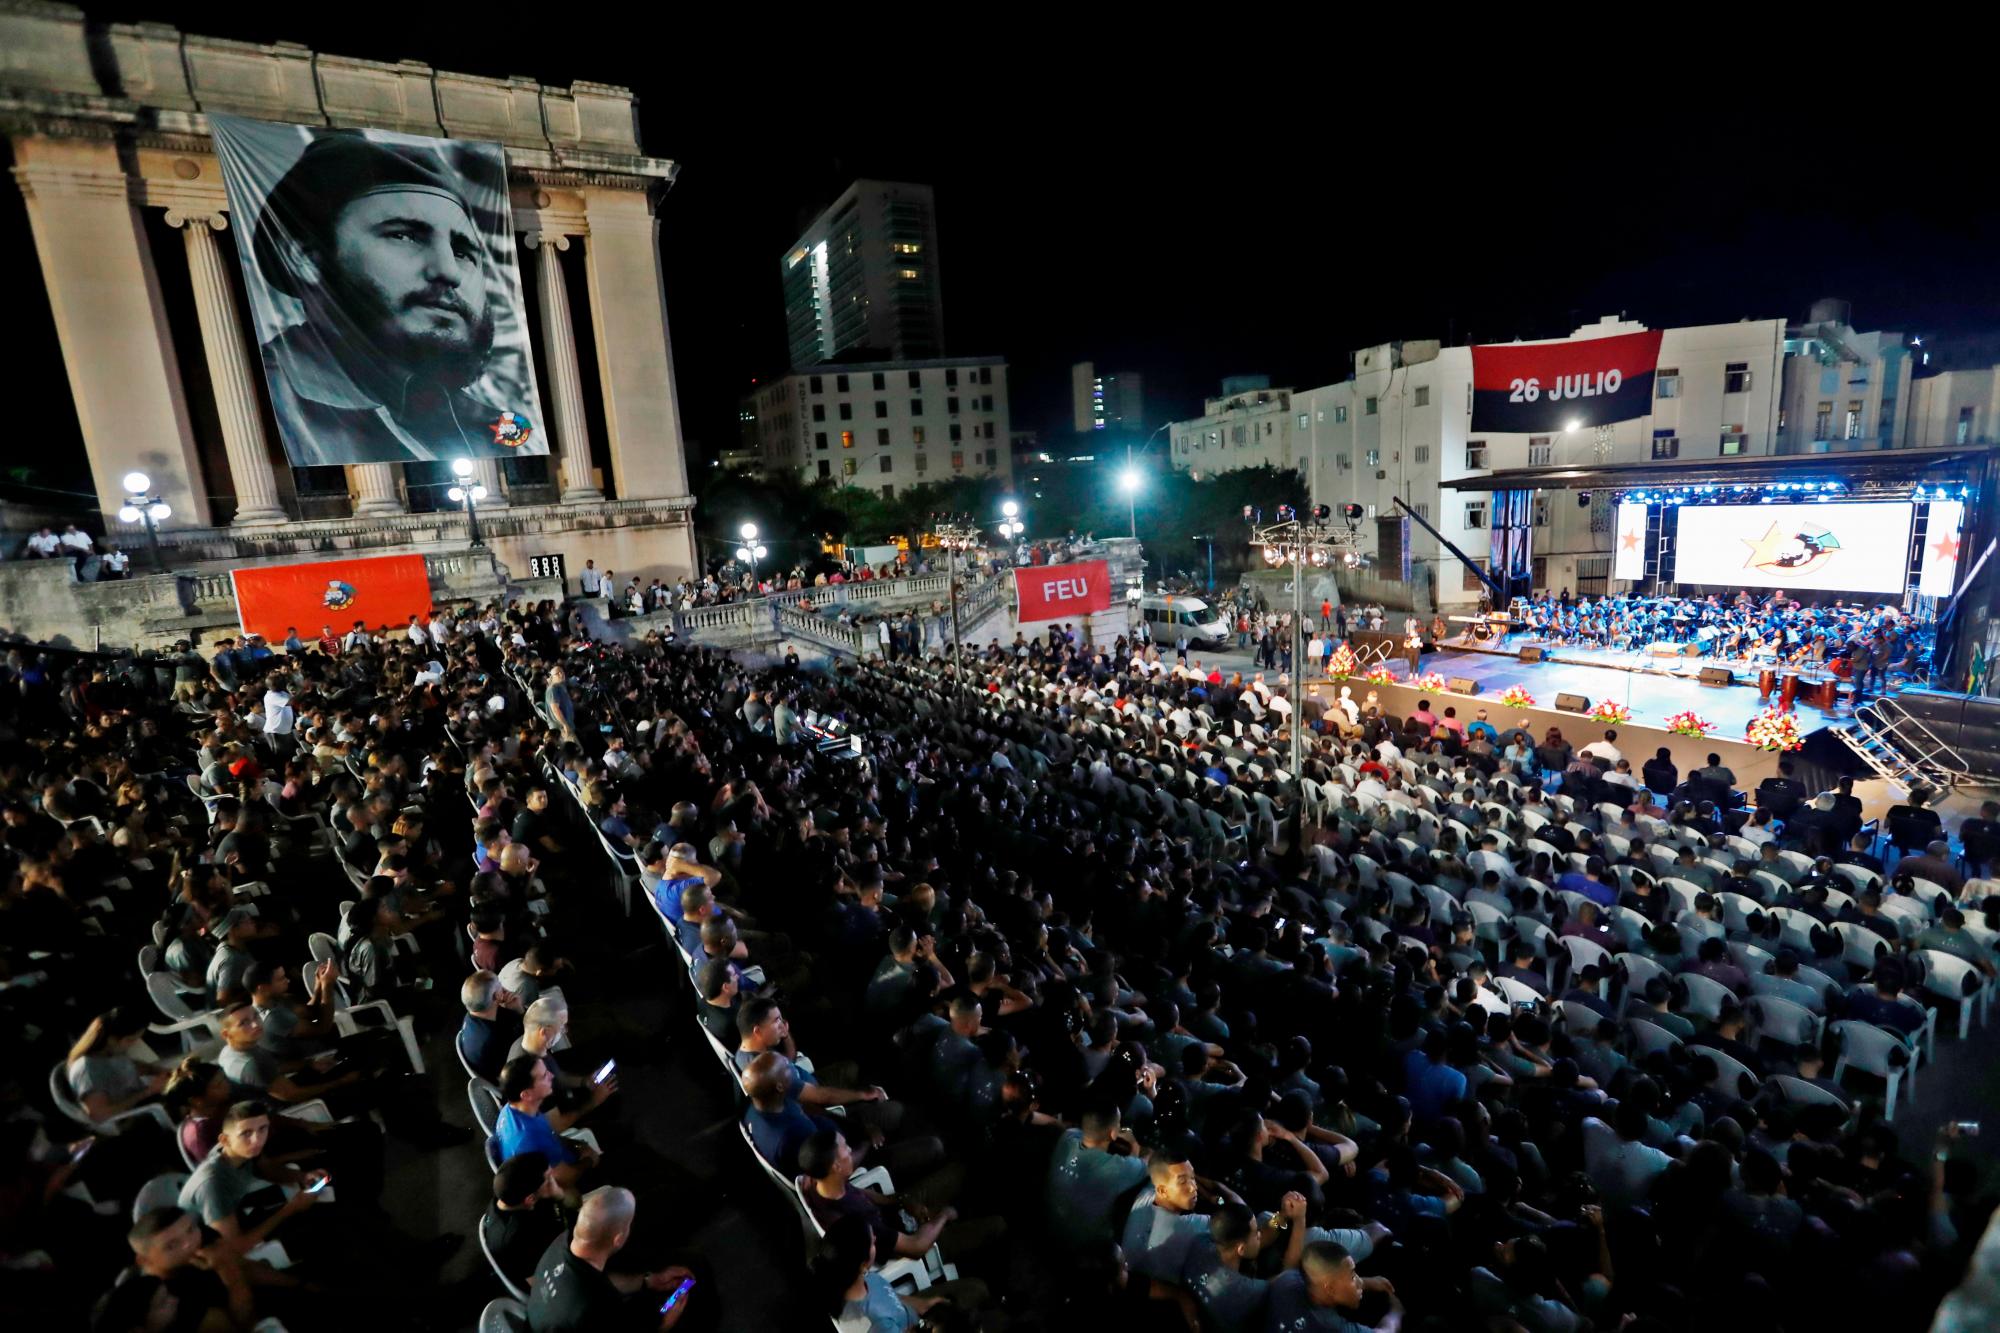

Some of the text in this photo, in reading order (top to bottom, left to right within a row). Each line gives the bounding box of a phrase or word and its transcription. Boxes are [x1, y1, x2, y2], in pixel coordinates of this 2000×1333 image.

[1509, 368, 1622, 403] 26 JULIO
[1043, 577, 1088, 602] FEU
